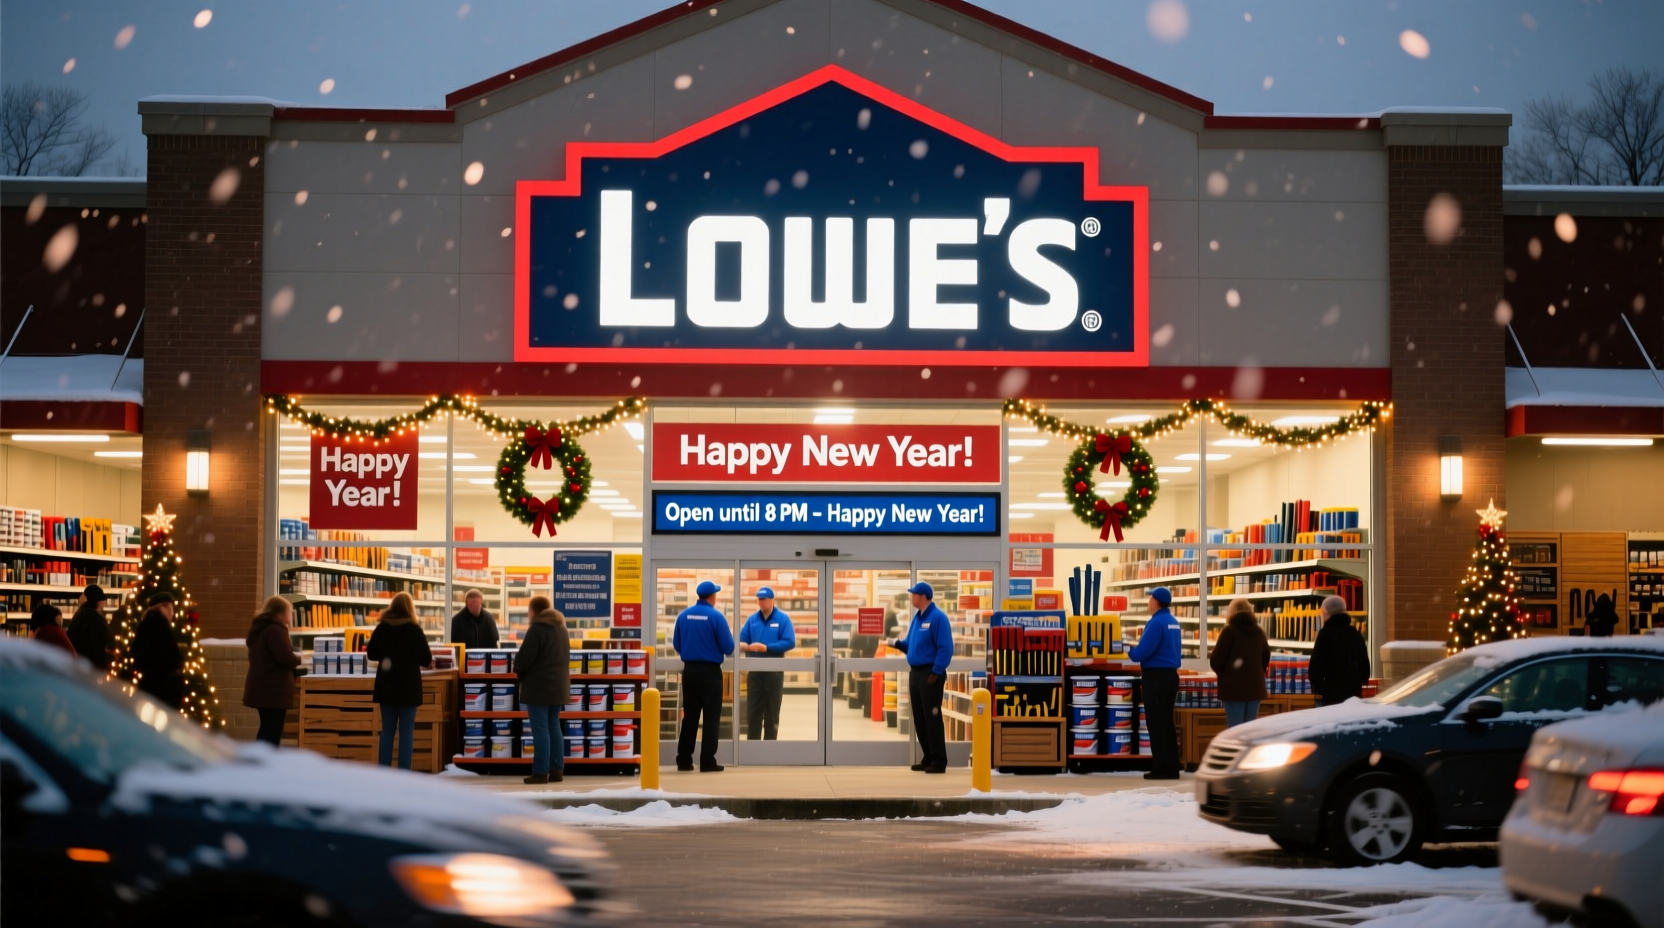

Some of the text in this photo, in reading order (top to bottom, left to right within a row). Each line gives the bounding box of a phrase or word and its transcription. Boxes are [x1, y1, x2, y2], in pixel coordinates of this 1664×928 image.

[599, 189, 1079, 332] LOWE'S
[320, 446, 410, 480] Happy
[680, 434, 973, 475] Happy New Year!
[324, 479, 401, 507] Year!
[665, 502, 714, 528] Open
[719, 502, 760, 522] until
[764, 503, 777, 522] 8
[780, 503, 808, 522] PM
[827, 503, 887, 528] Happy
[891, 504, 933, 523] New
[937, 504, 984, 523] Year!
